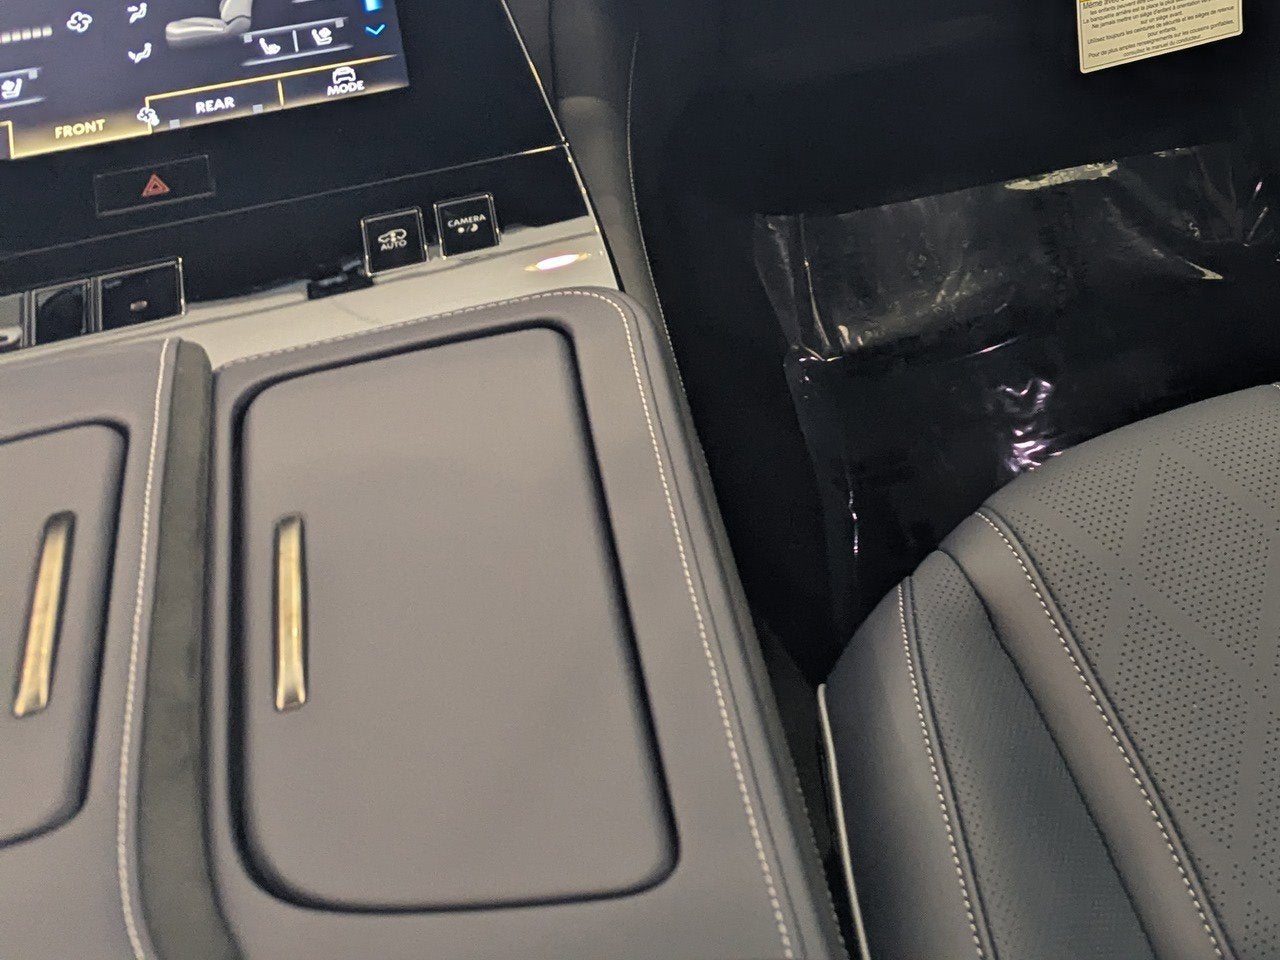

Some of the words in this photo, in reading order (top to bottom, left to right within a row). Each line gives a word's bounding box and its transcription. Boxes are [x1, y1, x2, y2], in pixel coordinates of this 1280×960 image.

[327, 80, 365, 97] MODE
[195, 96, 235, 115] REAR
[55, 119, 105, 139] FRONT
[447, 214, 487, 228] CAMERA
[381, 240, 408, 251] AUTO
